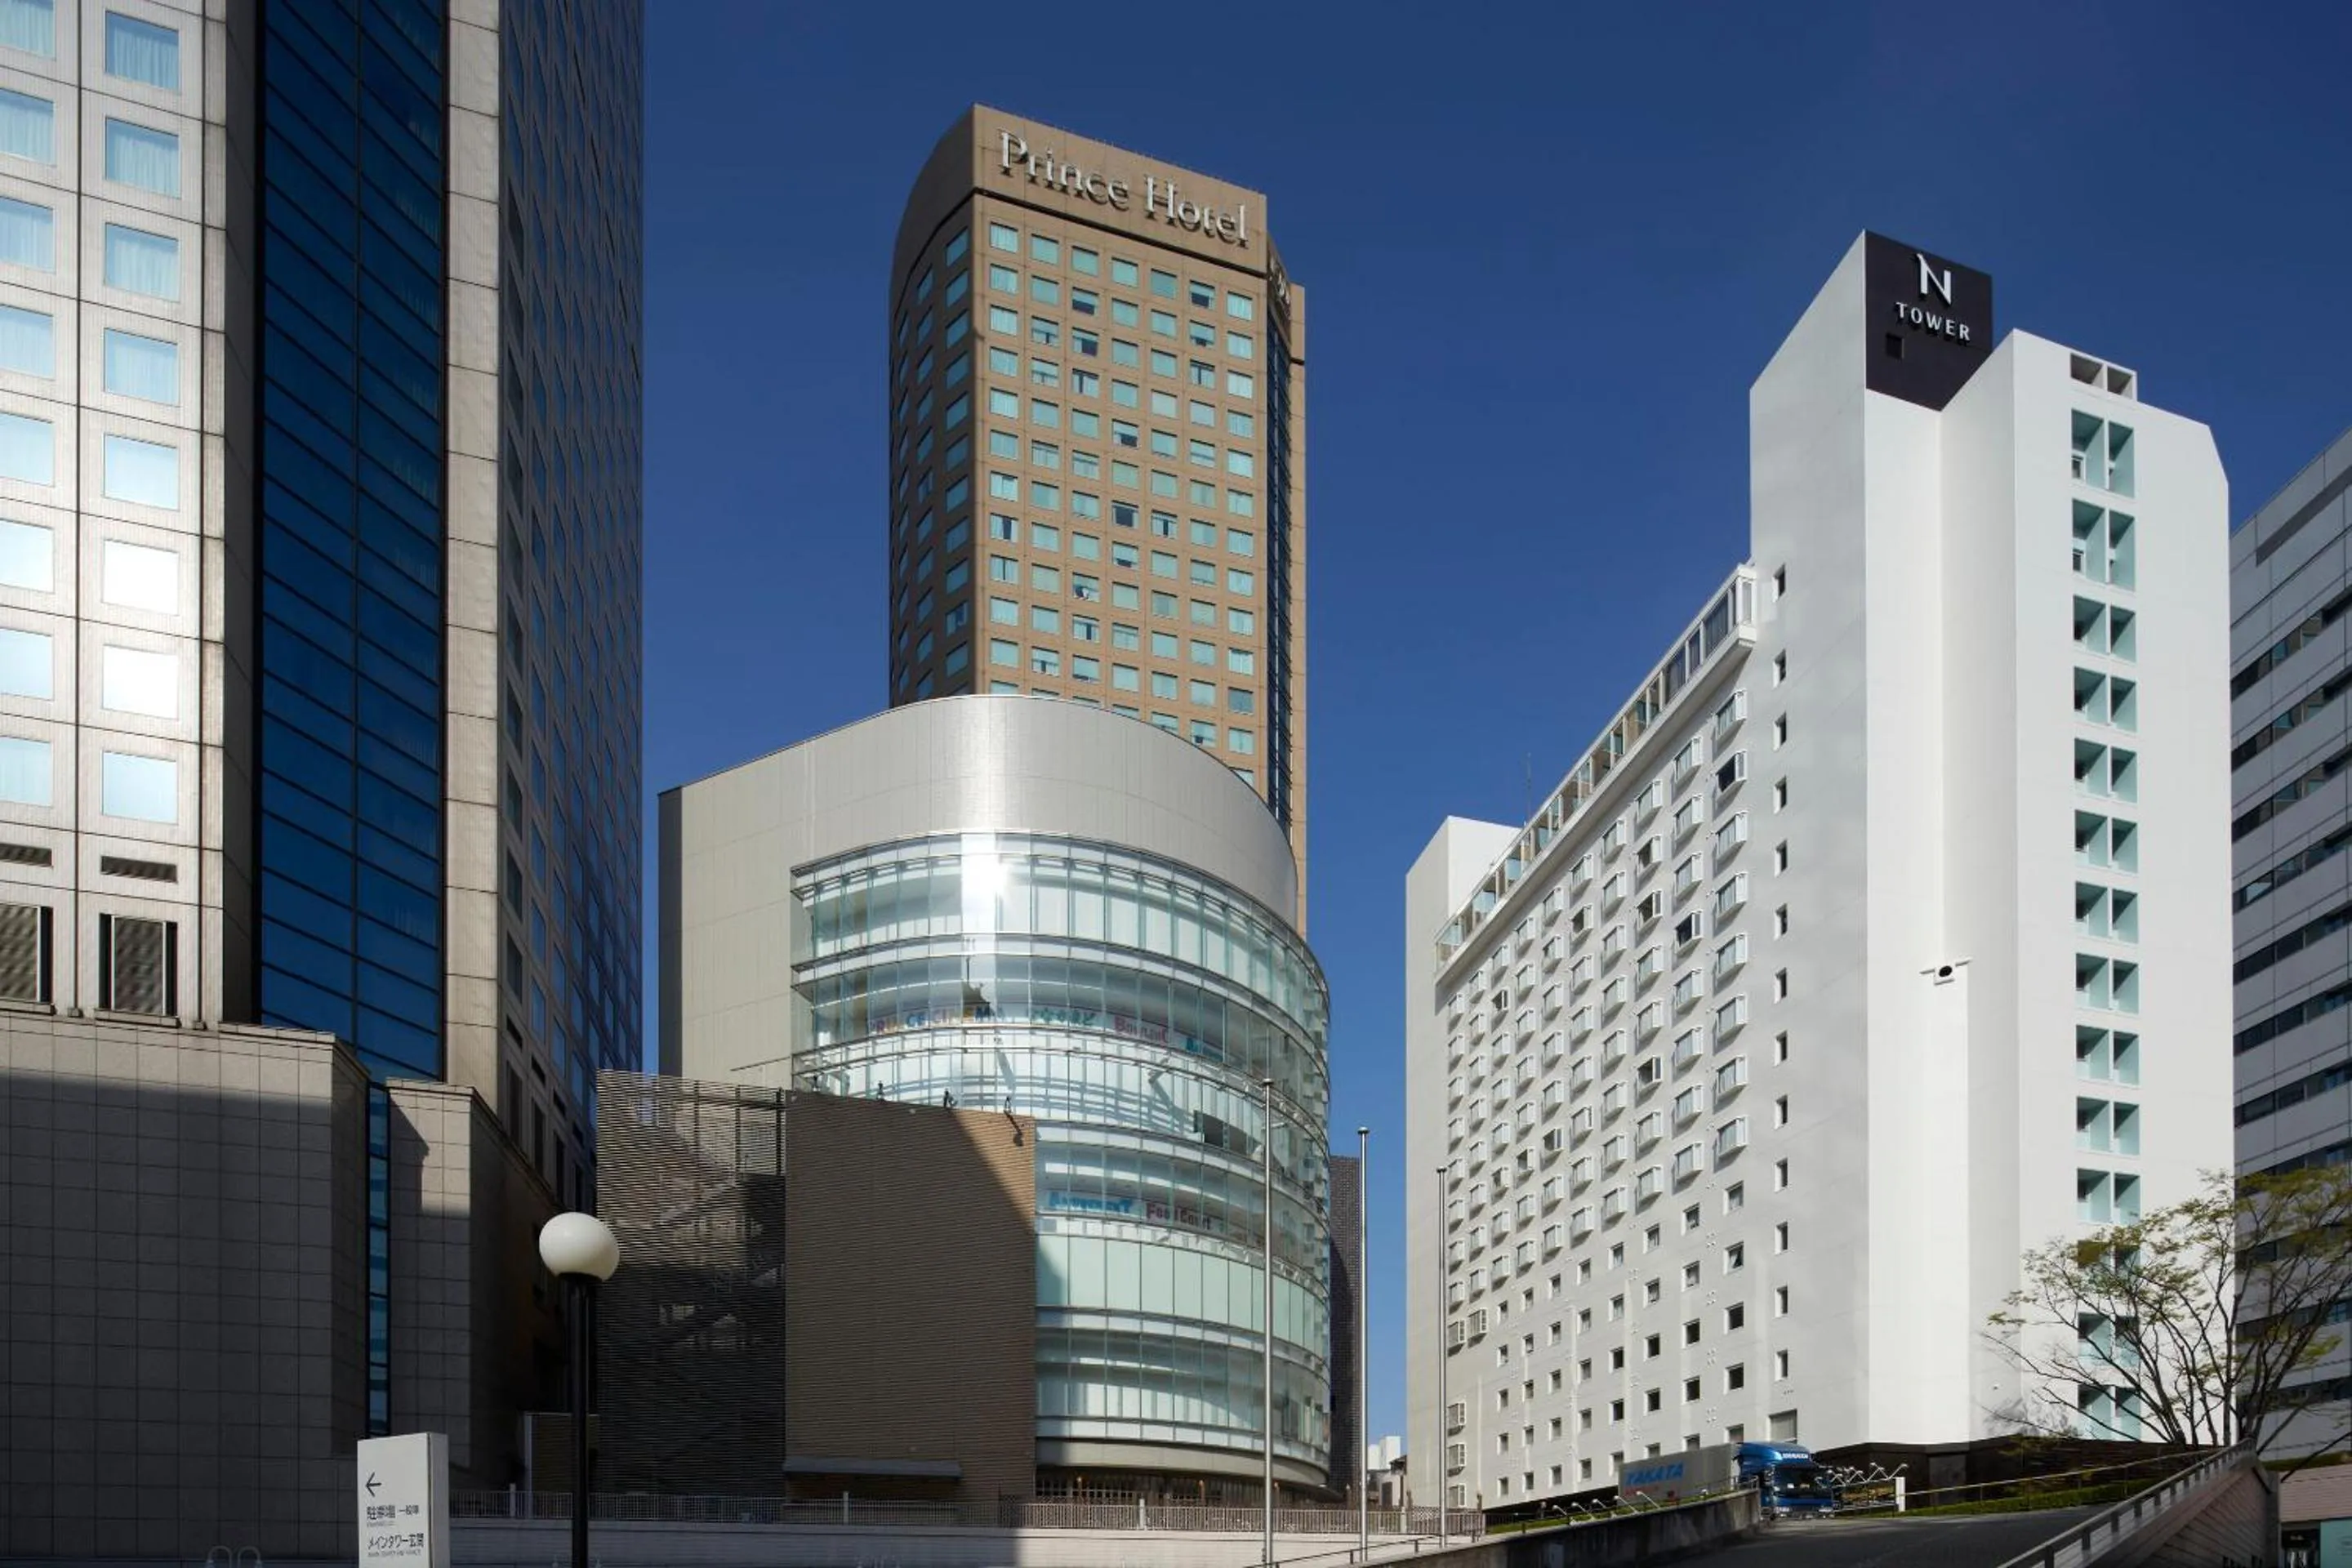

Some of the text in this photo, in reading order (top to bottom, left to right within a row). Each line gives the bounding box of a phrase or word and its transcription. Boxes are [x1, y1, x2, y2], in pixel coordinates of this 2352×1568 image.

[999, 129, 1248, 248] Prince Hotel
[1916, 253, 1952, 305] N
[1895, 301, 1971, 341] TOWER
